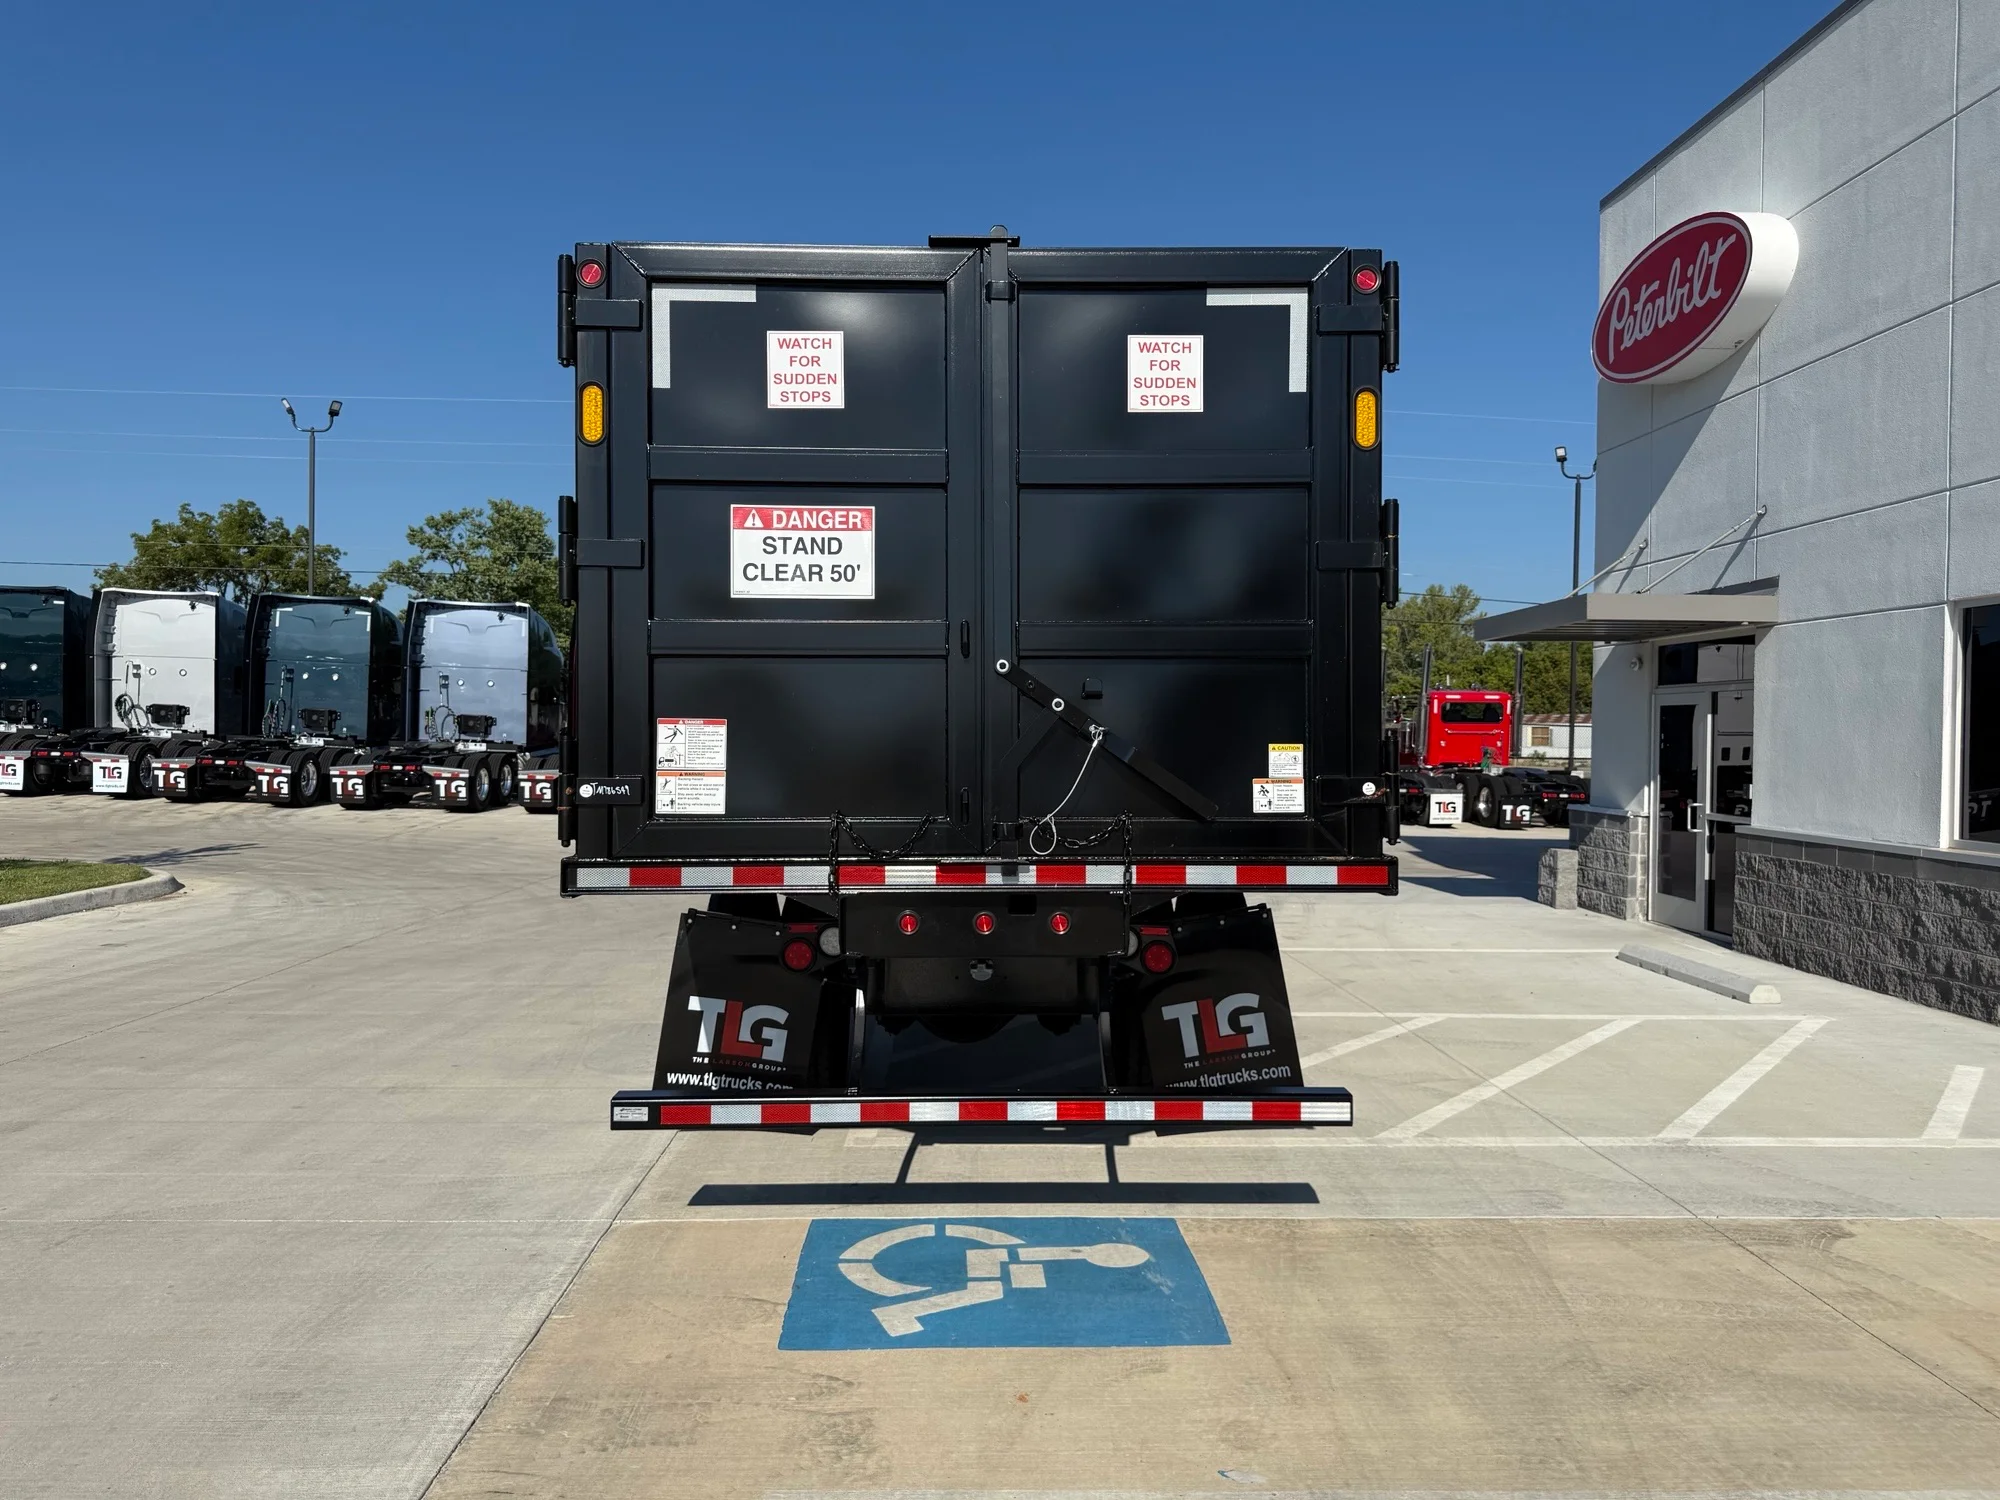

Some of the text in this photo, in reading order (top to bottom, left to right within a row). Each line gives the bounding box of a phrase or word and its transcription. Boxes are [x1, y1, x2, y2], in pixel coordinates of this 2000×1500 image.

[1609, 233, 1737, 364] Peterbilt
[777, 337, 832, 349] WATCH
[1138, 341, 1192, 354] WATCH
[789, 355, 821, 367] FOR
[1149, 359, 1181, 371] FOR
[773, 373, 837, 385] SUDDEN
[1133, 377, 1196, 389] SUDDEN
[780, 391, 832, 402] STOPS
[1140, 394, 1190, 406] STOPS
[772, 510, 863, 529] DANGER
[762, 536, 843, 555] STAND
[742, 562, 861, 583] CLEAR 50'
[99, 766, 122, 779] TLG
[154, 770, 186, 788] TLG
[258, 775, 289, 794] TLG
[332, 778, 364, 796] TLG
[435, 780, 467, 797] TLG
[520, 781, 552, 799] TLG
[1435, 801, 1457, 813] TLG
[1502, 805, 1531, 821] TLG
[687, 995, 790, 1063] TLG
[1161, 992, 1270, 1059] TLG
[692, 1056, 709, 1064] THE
[1184, 1061, 1200, 1069] THE
